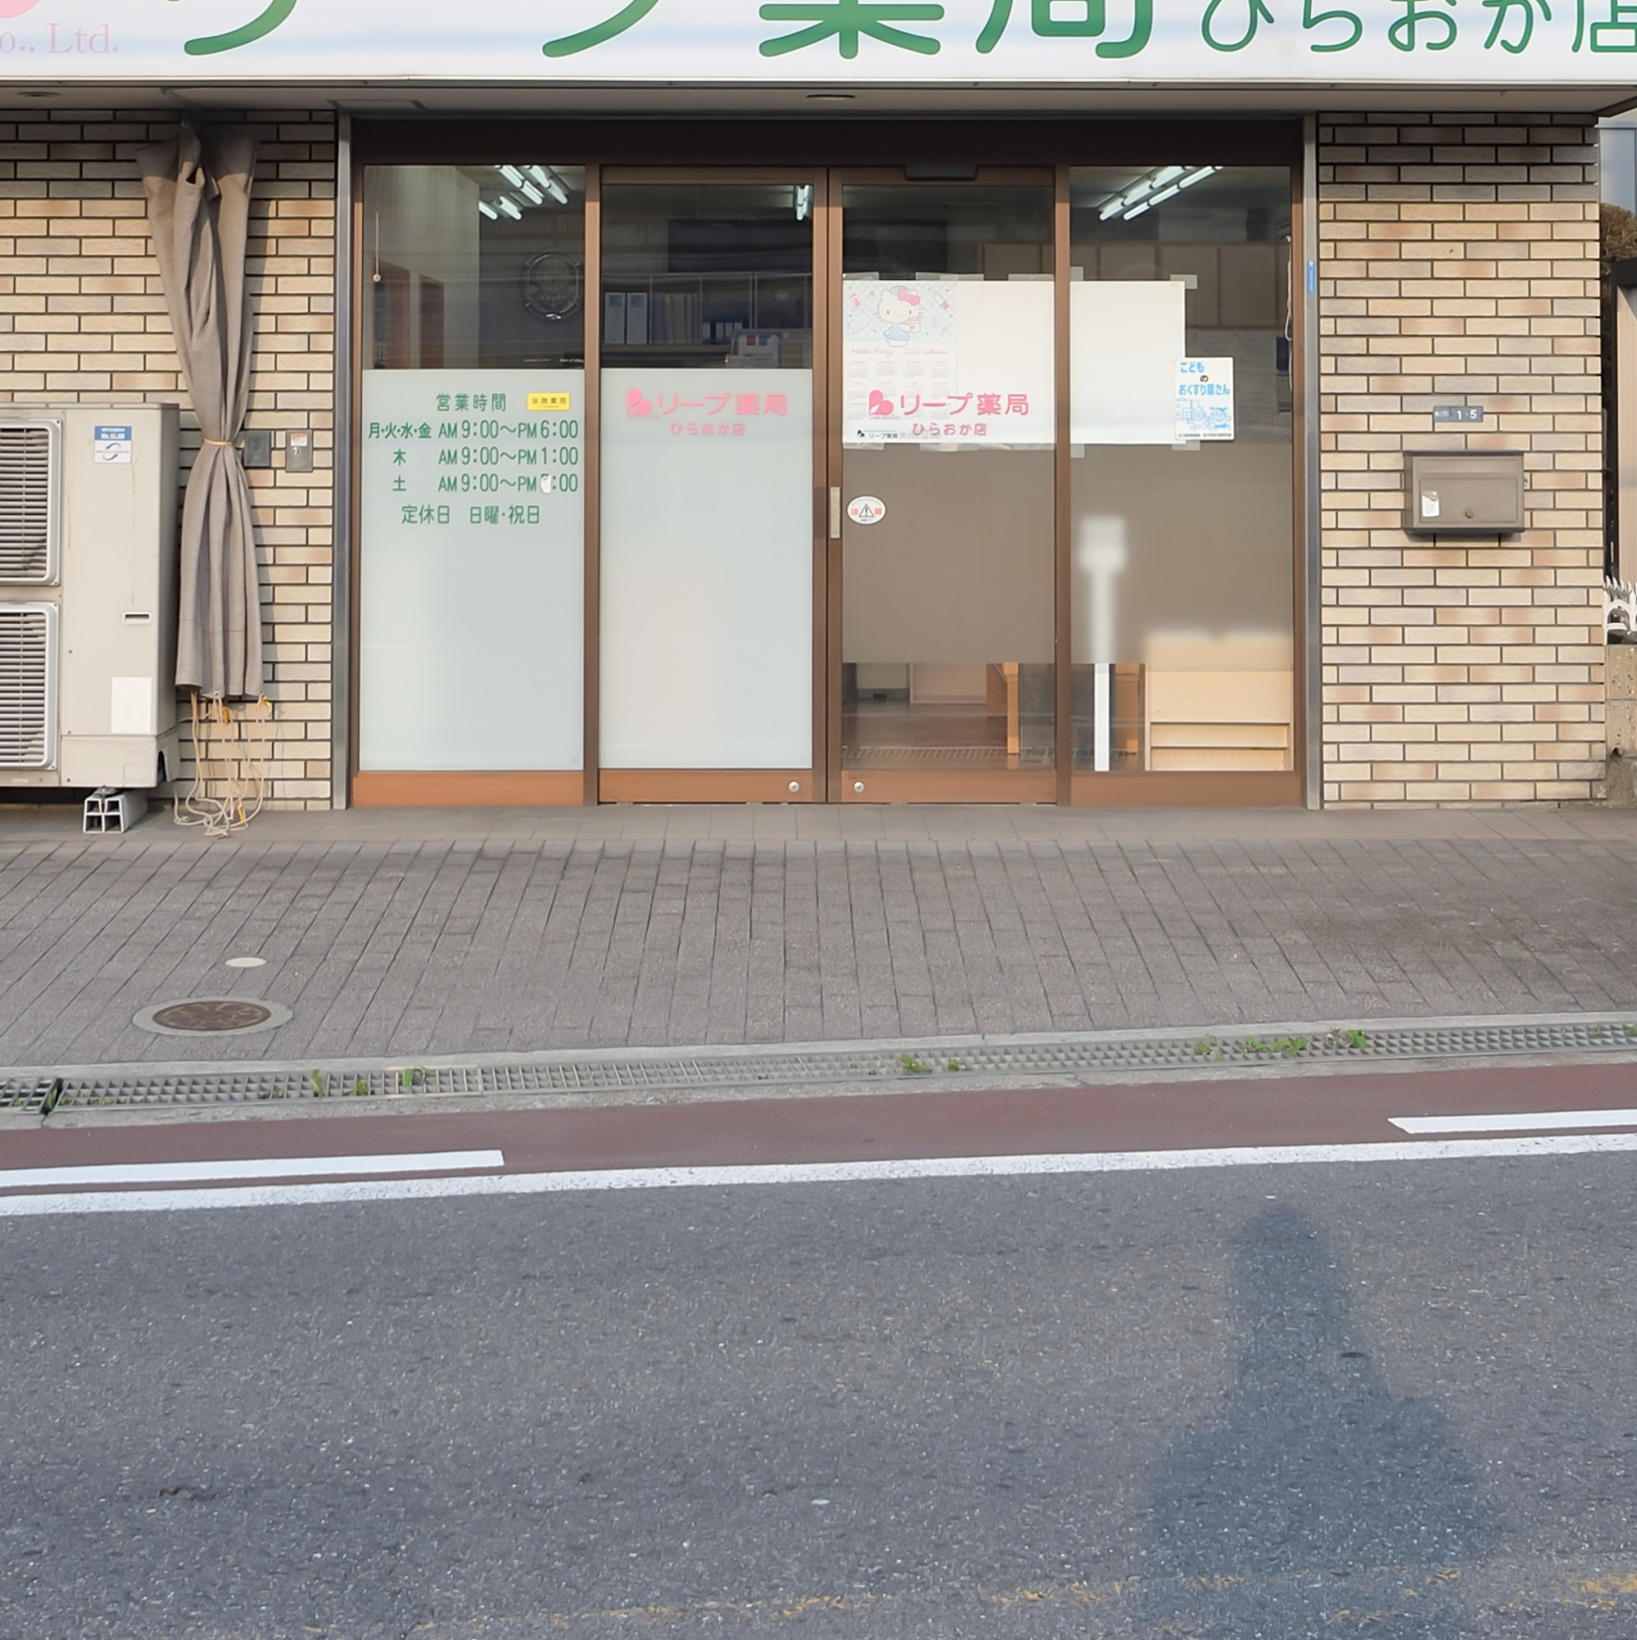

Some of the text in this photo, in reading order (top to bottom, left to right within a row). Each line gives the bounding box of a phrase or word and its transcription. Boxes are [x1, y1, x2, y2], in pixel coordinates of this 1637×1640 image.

[1179, 361, 1205, 373] こども
[1199, 374, 1209, 383] の
[436, 393, 507, 412] 営業時間
[657, 392, 789, 416] リープ薬局
[899, 392, 1030, 416] リープ薬局
[669, 421, 747, 437] ひらおか店
[912, 422, 987, 437] ひらおか店
[393, 448, 406, 466] 木
[392, 475, 407, 492] 土
[401, 504, 540, 525] 定休日 日曜・祝日
